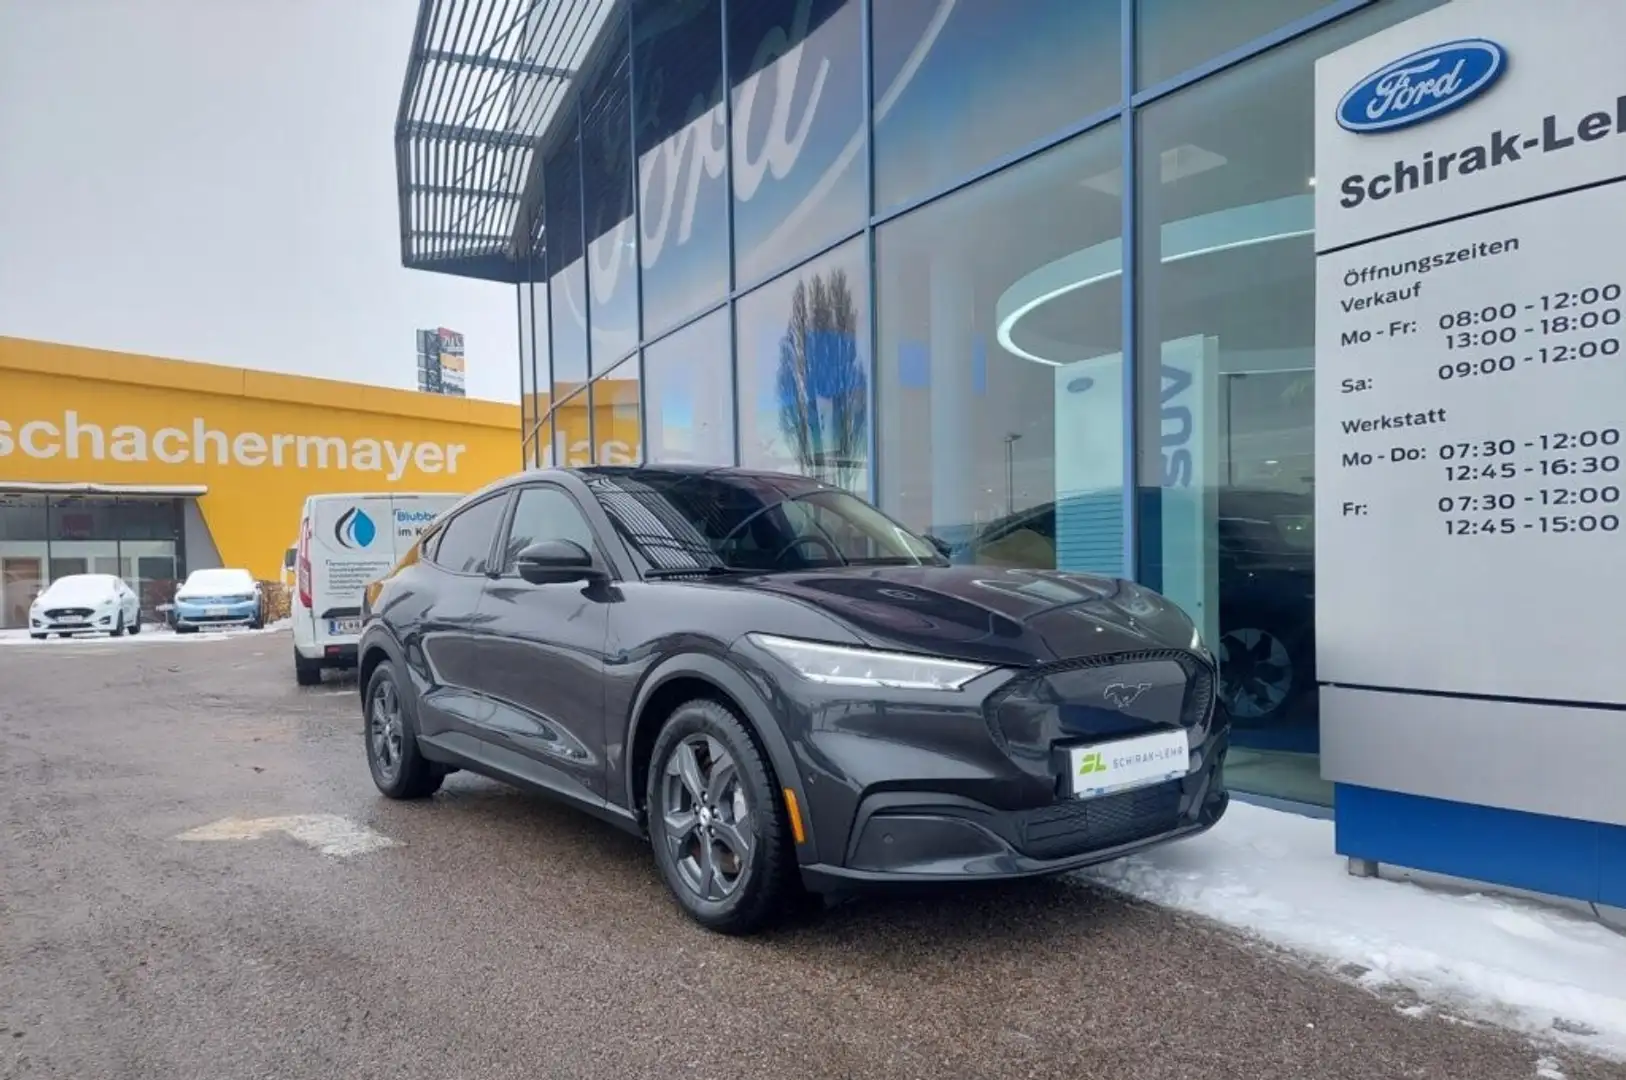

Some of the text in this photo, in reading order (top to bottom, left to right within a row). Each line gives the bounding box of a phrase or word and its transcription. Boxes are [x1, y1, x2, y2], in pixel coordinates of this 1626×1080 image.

[1365, 58, 1466, 119] Ford
[1344, 237, 1519, 287] Öffnungszeiten
[1341, 281, 1421, 313] Verkauf
[1341, 330, 1371, 347] Mo
[1390, 320, 1417, 338] Fr:
[1439, 303, 1516, 330] 08:00
[1540, 284, 1621, 311] 12:00
[1446, 327, 1516, 350] 13:00
[1541, 308, 1620, 335] 18:00
[1341, 378, 1373, 394] Sa:
[1439, 355, 1515, 380] 09:00
[1539, 339, 1619, 363] 12:00
[1160, 364, 1192, 488] SUV
[1341, 408, 1447, 434] Werkstatt
[1342, 452, 1372, 467] Mo
[1391, 447, 1426, 463] Do:
[1439, 439, 1515, 460] 07:30
[1540, 429, 1619, 450] 12:00
[1446, 463, 1516, 481] 12:45
[1540, 456, 1620, 476] 16:30
[1343, 502, 1368, 516] Fr:
[1438, 494, 1515, 512] 07:30
[1540, 486, 1619, 505] 12:00
[1446, 518, 1515, 535] 12:45
[1539, 515, 1619, 533] 15:00
